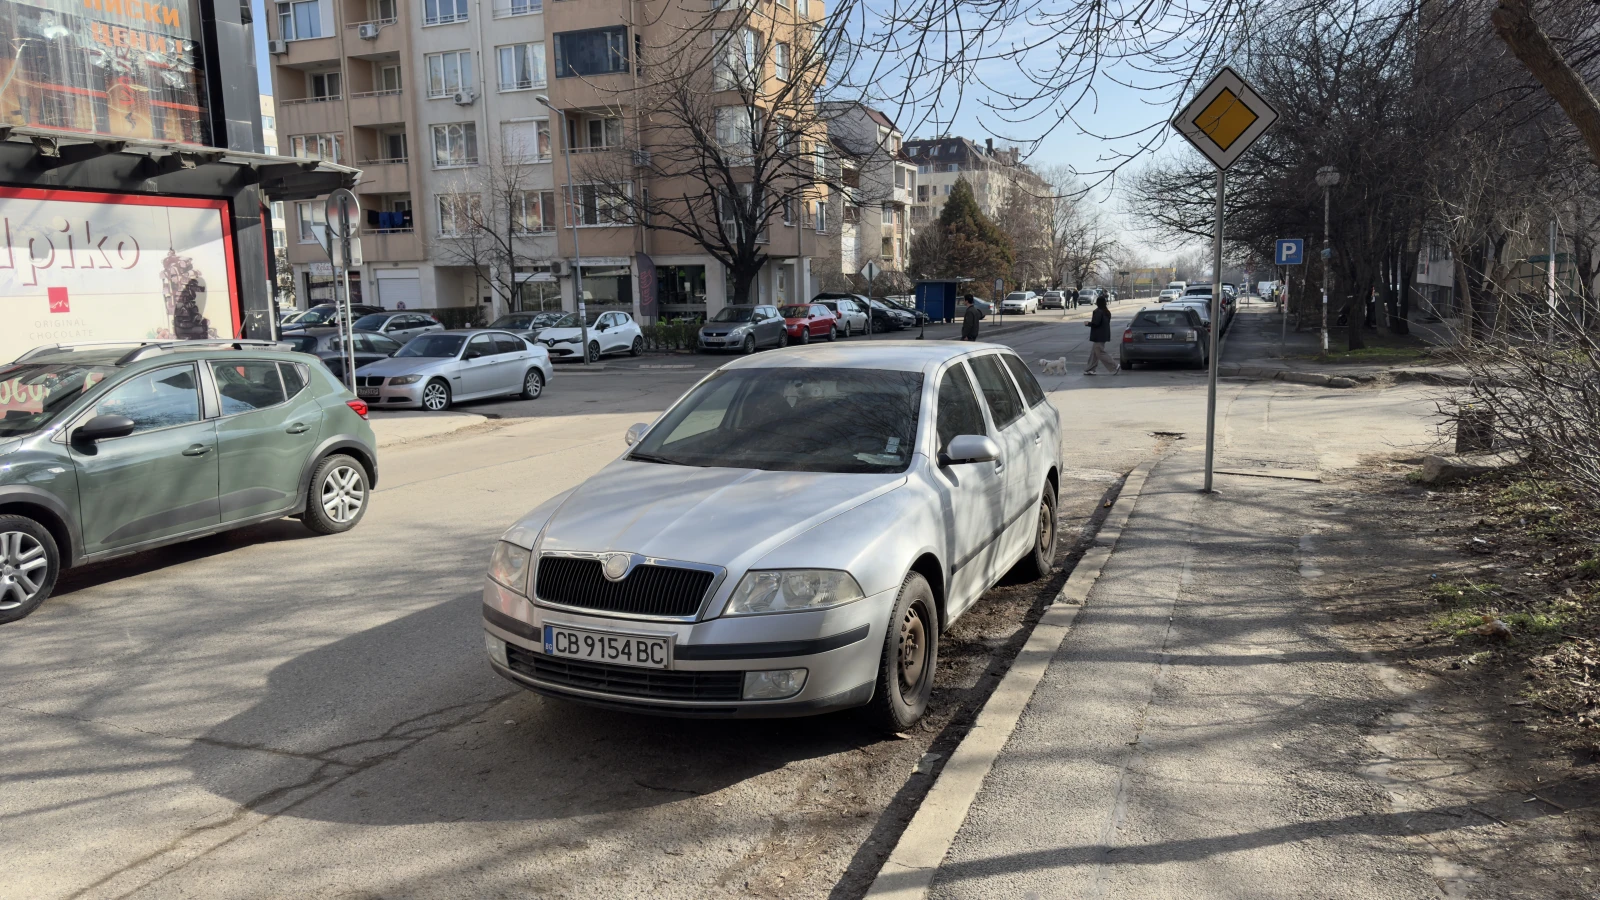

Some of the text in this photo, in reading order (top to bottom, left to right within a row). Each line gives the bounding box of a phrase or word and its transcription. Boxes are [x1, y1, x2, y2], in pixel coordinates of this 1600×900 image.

[1281, 242, 1297, 262] P
[34, 318, 87, 329] ORIGINAL
[29, 329, 93, 341] CHOCOLATE
[555, 631, 664, 665] CB 9154 BC
